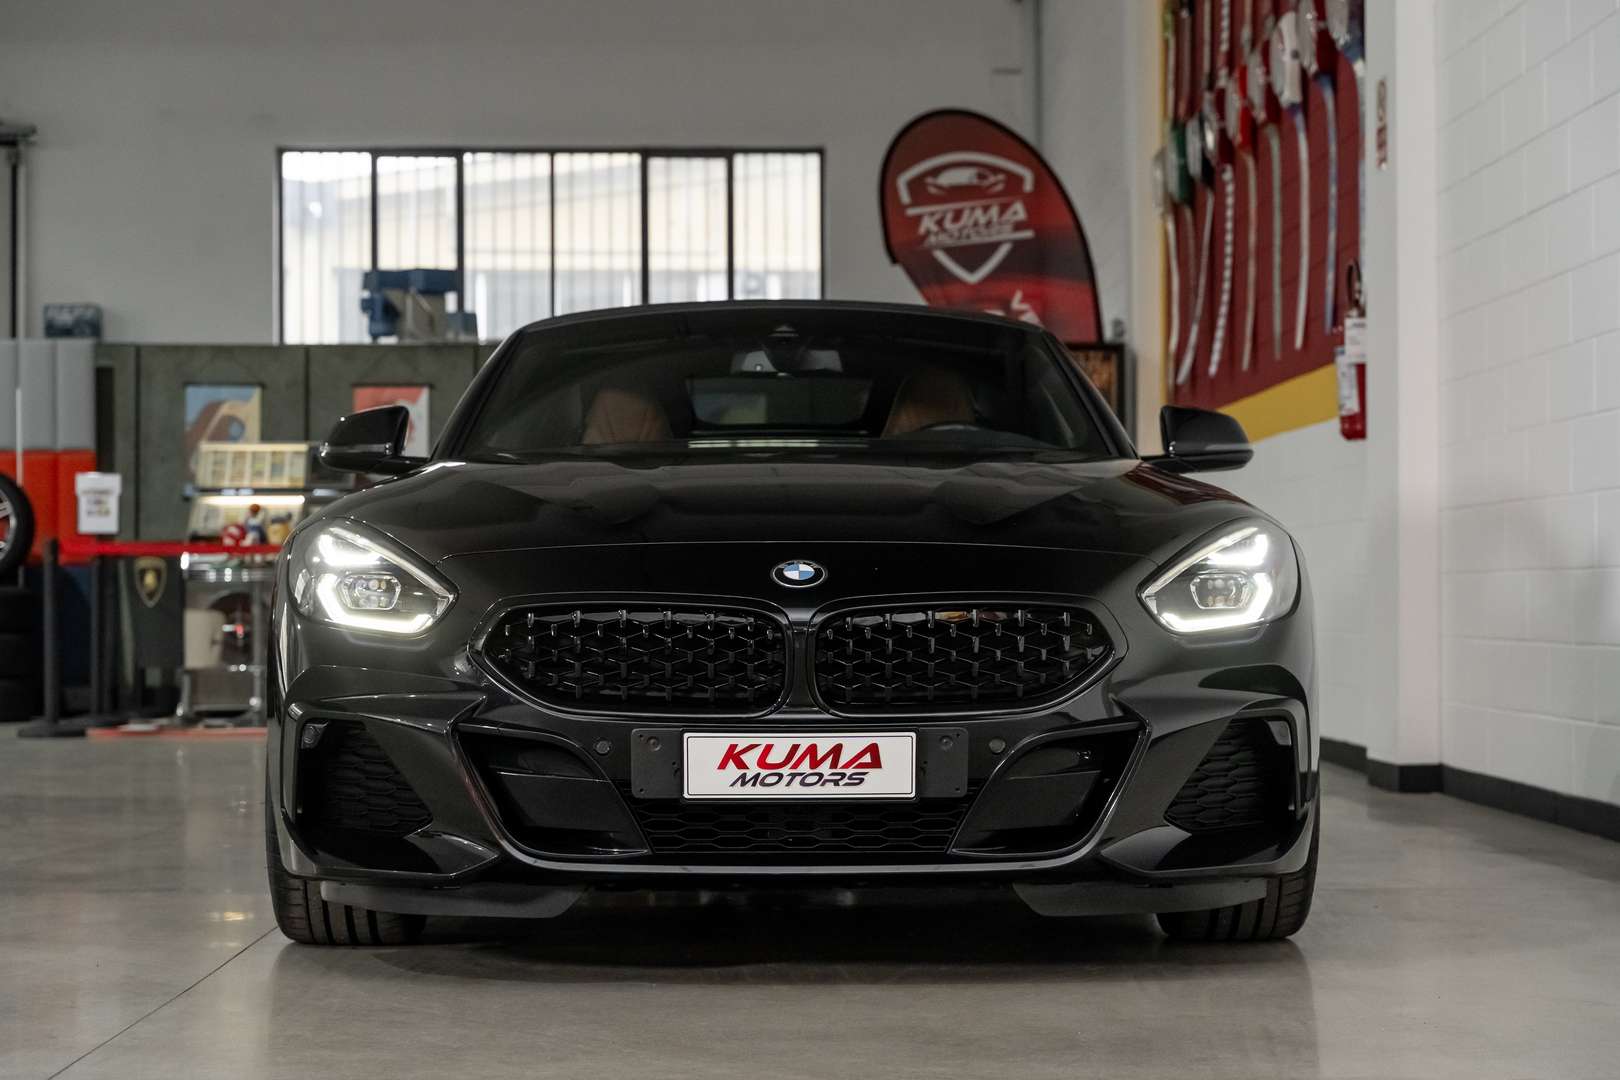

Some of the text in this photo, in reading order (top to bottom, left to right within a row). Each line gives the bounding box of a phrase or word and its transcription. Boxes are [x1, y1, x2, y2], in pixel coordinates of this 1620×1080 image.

[919, 200, 1027, 234] KUMA
[717, 742, 883, 770] KUMA
[729, 771, 870, 788] MOTORS
